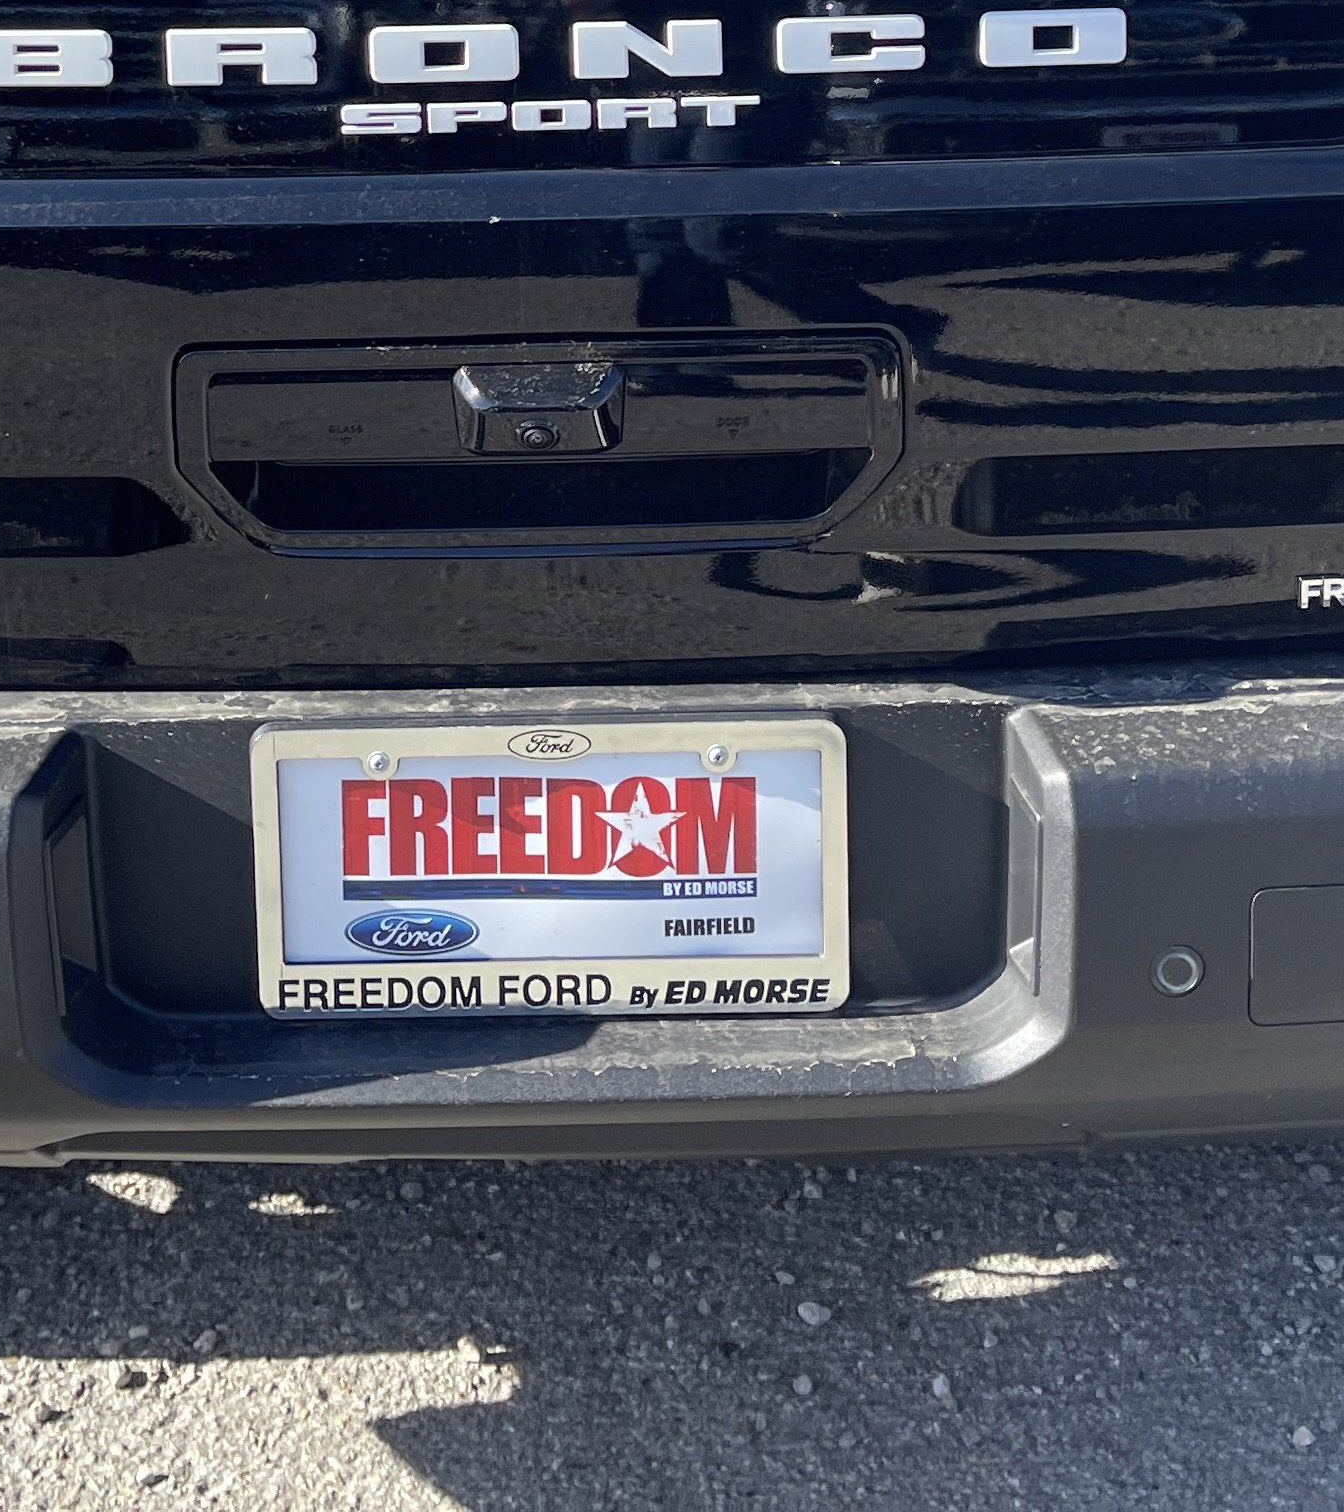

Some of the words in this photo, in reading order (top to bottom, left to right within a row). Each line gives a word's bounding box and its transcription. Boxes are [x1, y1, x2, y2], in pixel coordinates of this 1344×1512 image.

[341, 94, 761, 135] SPORT
[525, 733, 575, 754] Ford
[341, 776, 757, 877] FREEDOM
[662, 882, 682, 897] BY
[684, 881, 702, 896] ED
[705, 880, 754, 896] MORSE
[372, 916, 452, 947] Ford
[664, 916, 755, 937] FAIRFIELD
[278, 975, 482, 1011] FREEDOM
[498, 973, 612, 1009] FORD
[664, 980, 706, 1005] ED
[712, 978, 831, 1004] MORSE
